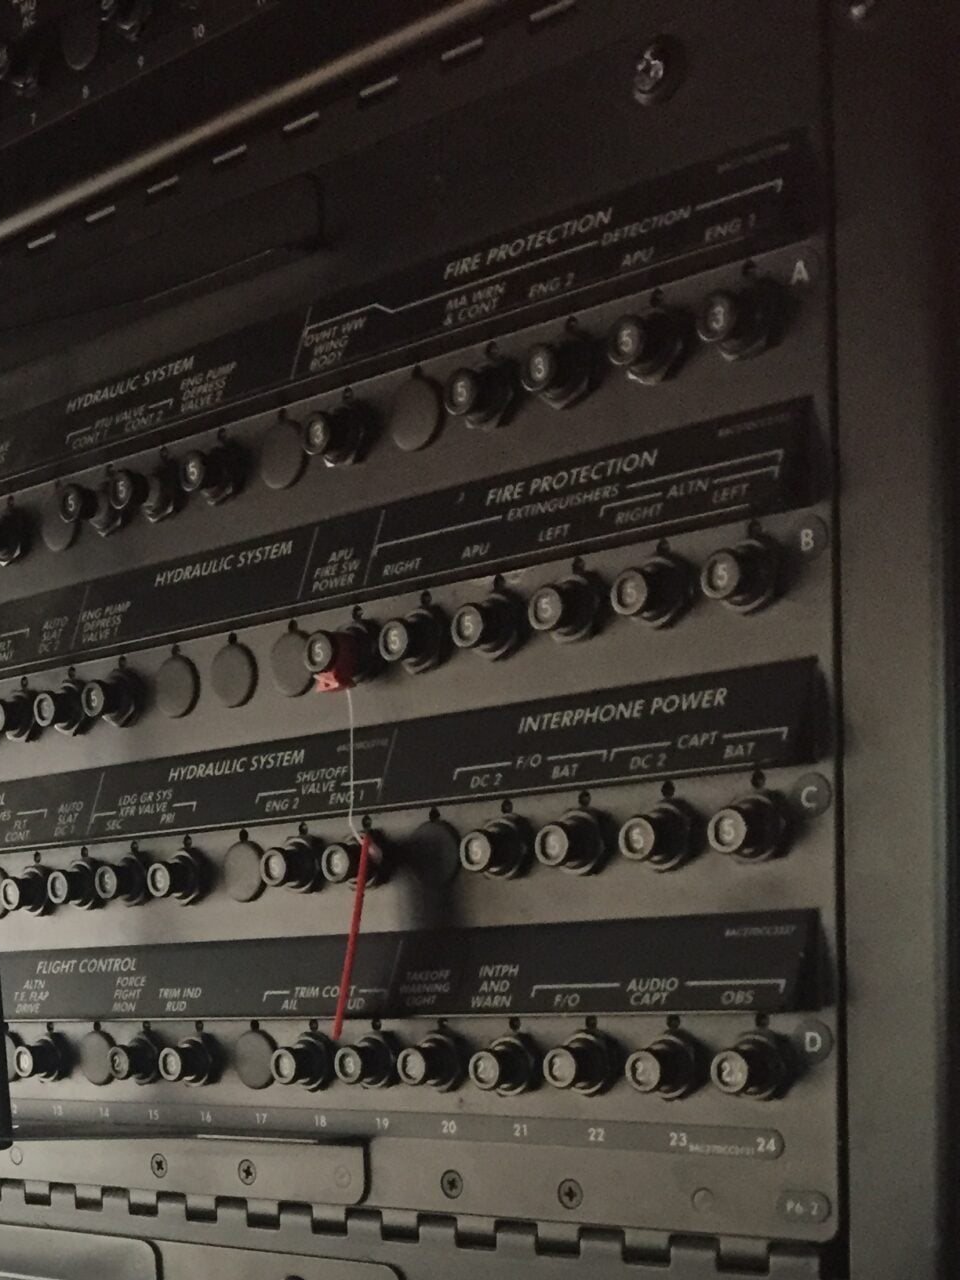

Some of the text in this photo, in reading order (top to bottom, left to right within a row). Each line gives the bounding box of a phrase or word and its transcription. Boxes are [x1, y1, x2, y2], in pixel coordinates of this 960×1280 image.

[601, 204, 692, 247] DETECTION
[444, 206, 614, 280] FIRE PROTECTION
[621, 247, 655, 268] APU
[790, 259, 810, 285] A
[66, 356, 195, 414] HYDRAULIC SYSTEM
[486, 449, 658, 506] FIRE PROTECTION
[666, 476, 710, 499] ALTN
[712, 483, 749, 503] LEFT
[507, 483, 620, 522] EXTINGUISHERS
[615, 503, 664, 525] RIGHT
[538, 523, 571, 543] LEFT
[801, 528, 815, 551] B
[328, 547, 354, 564] APU
[461, 543, 491, 560] APU
[154, 540, 293, 588] HYDRAULIC SYSTEM
[382, 557, 422, 577] RIGHT
[312, 572, 355, 592] POWER
[517, 687, 728, 735] INTERPHONE POWER
[677, 732, 719, 750] CAPT
[724, 742, 756, 760] BAT
[168, 749, 305, 783] HYDRAULIC SYSTEM
[552, 763, 579, 780] BAT
[629, 753, 667, 771] DC 2
[301, 780, 337, 796] VALVE
[800, 785, 818, 808] C
[37, 957, 137, 975] FLIGHT CONTROL
[479, 964, 519, 979] INTPH
[294, 985, 356, 999] TRIM COT
[479, 979, 510, 993] AND
[626, 977, 679, 992] AUDIO
[471, 995, 512, 1008] WARN
[630, 992, 669, 1007] CAPT
[804, 1030, 822, 1052] D
[441, 1121, 457, 1133] 20
[513, 1123, 528, 1137] 21
[588, 1128, 605, 1141] 22
[669, 1132, 688, 1147] 23
[756, 1137, 777, 1153] 24
